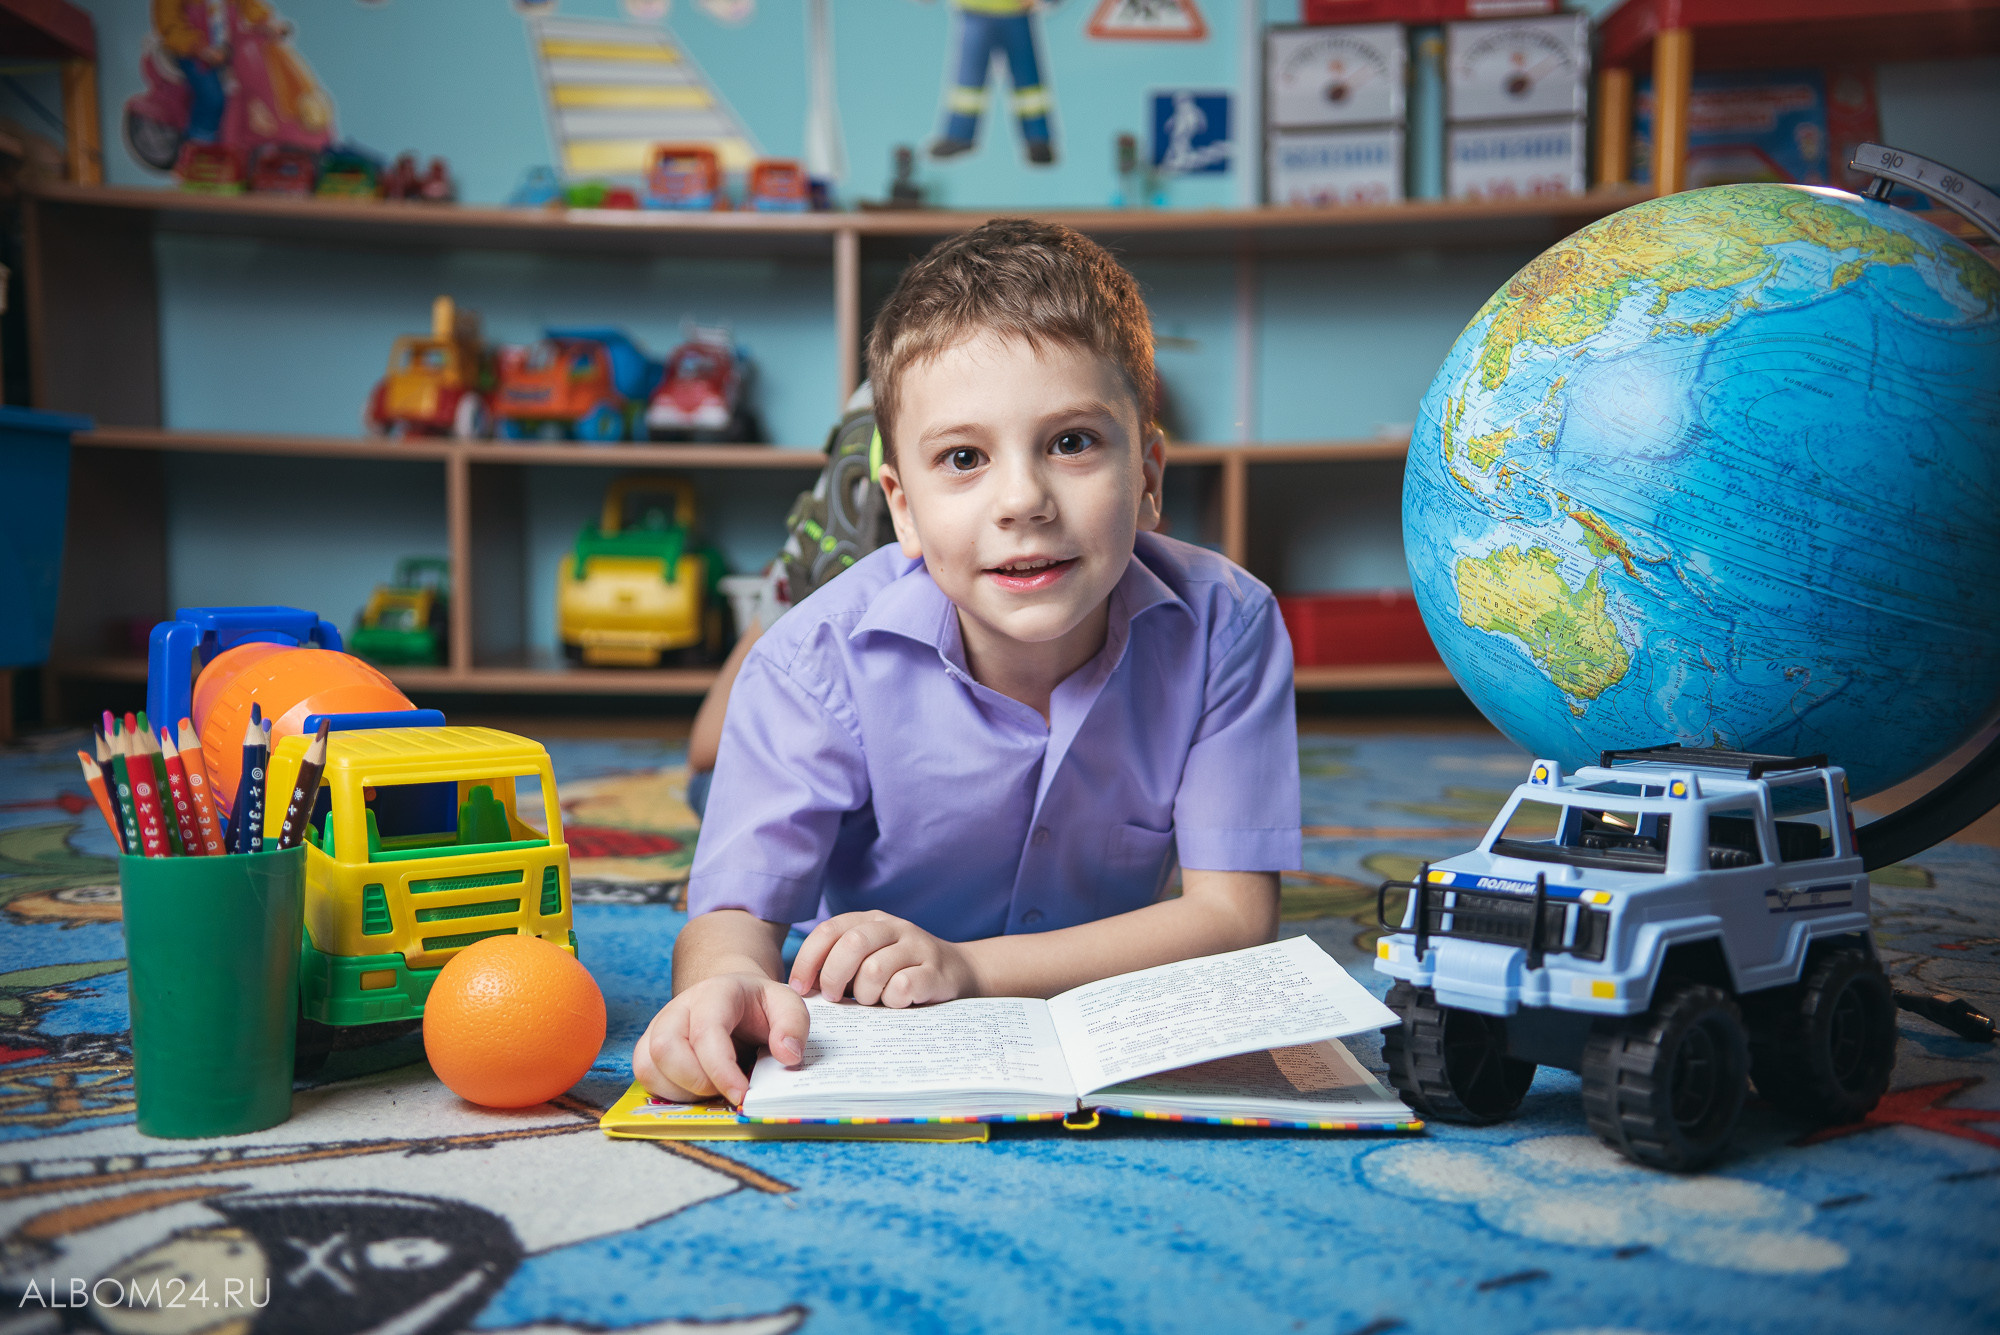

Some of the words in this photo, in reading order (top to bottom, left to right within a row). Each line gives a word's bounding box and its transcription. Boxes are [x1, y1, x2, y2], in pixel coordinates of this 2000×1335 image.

[1783, 376, 1835, 399] котловина
[1482, 596, 1595, 653] АВСТРАЛИЯ
[1477, 877, 1538, 896] ПОЛИЦИ
